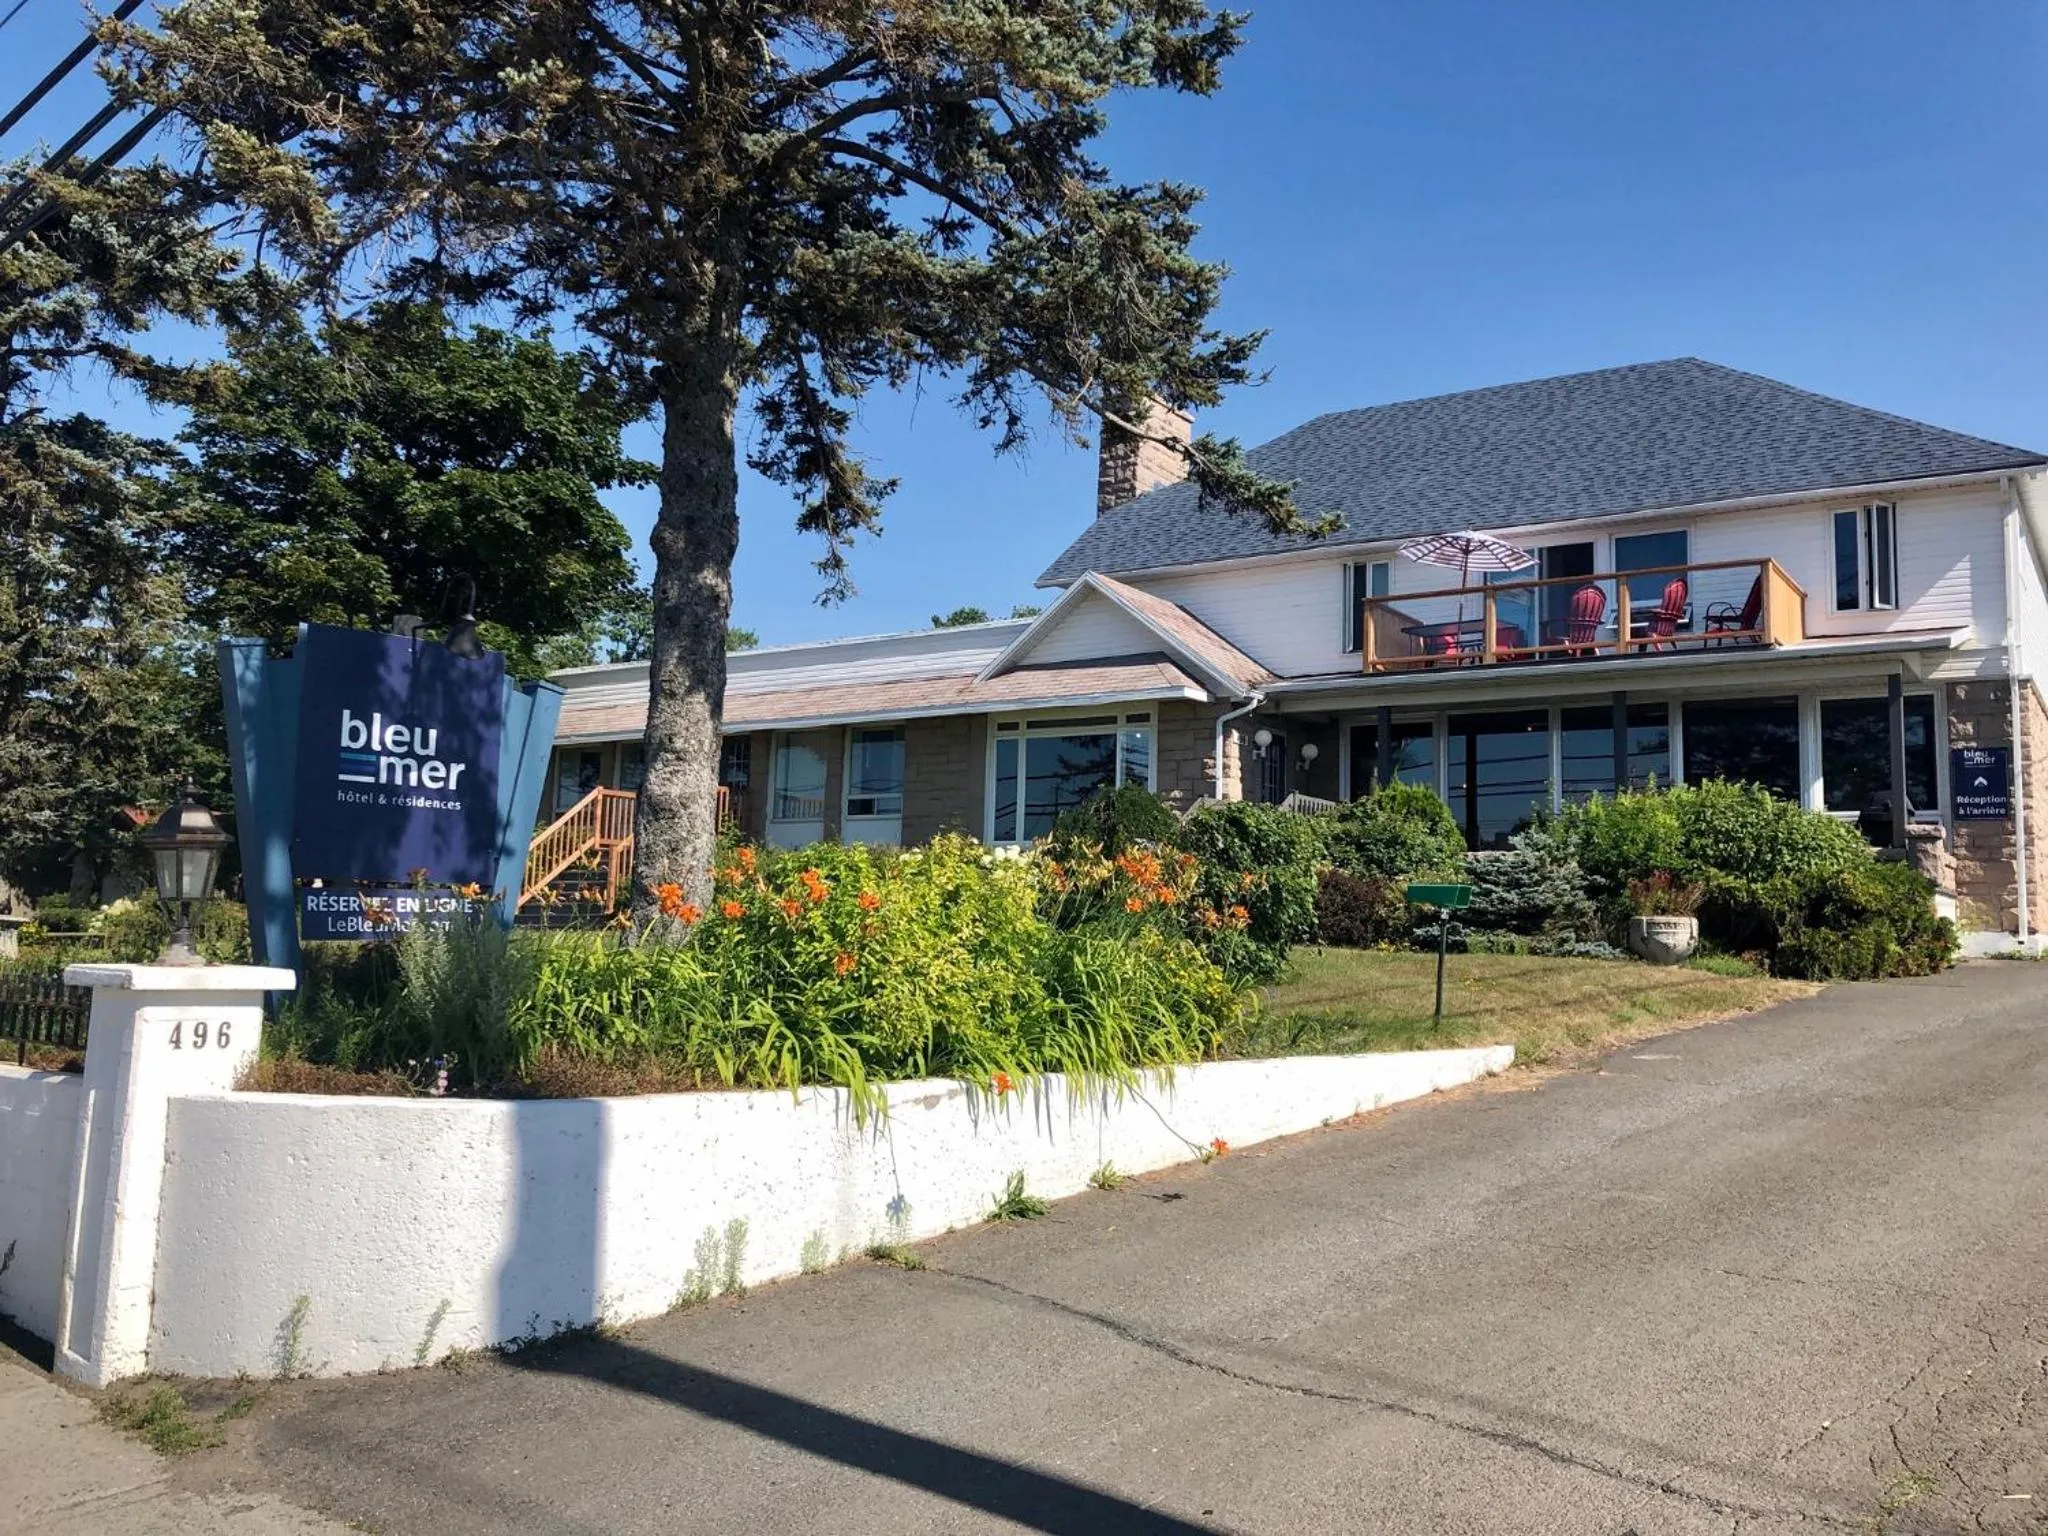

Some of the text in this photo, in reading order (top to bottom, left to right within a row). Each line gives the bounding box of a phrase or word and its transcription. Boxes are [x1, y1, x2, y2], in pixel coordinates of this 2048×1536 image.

[340, 709, 438, 756] bleu
[1964, 750, 1988, 758] bleu
[378, 754, 466, 790] mer
[338, 790, 462, 810] hôtel & résidences
[1957, 796, 2006, 805] Réception
[1967, 806, 2006, 814] l'arrière
[396, 897, 420, 912] EN
[425, 897, 473, 913] LIGNE
[168, 1021, 232, 1050] 496
